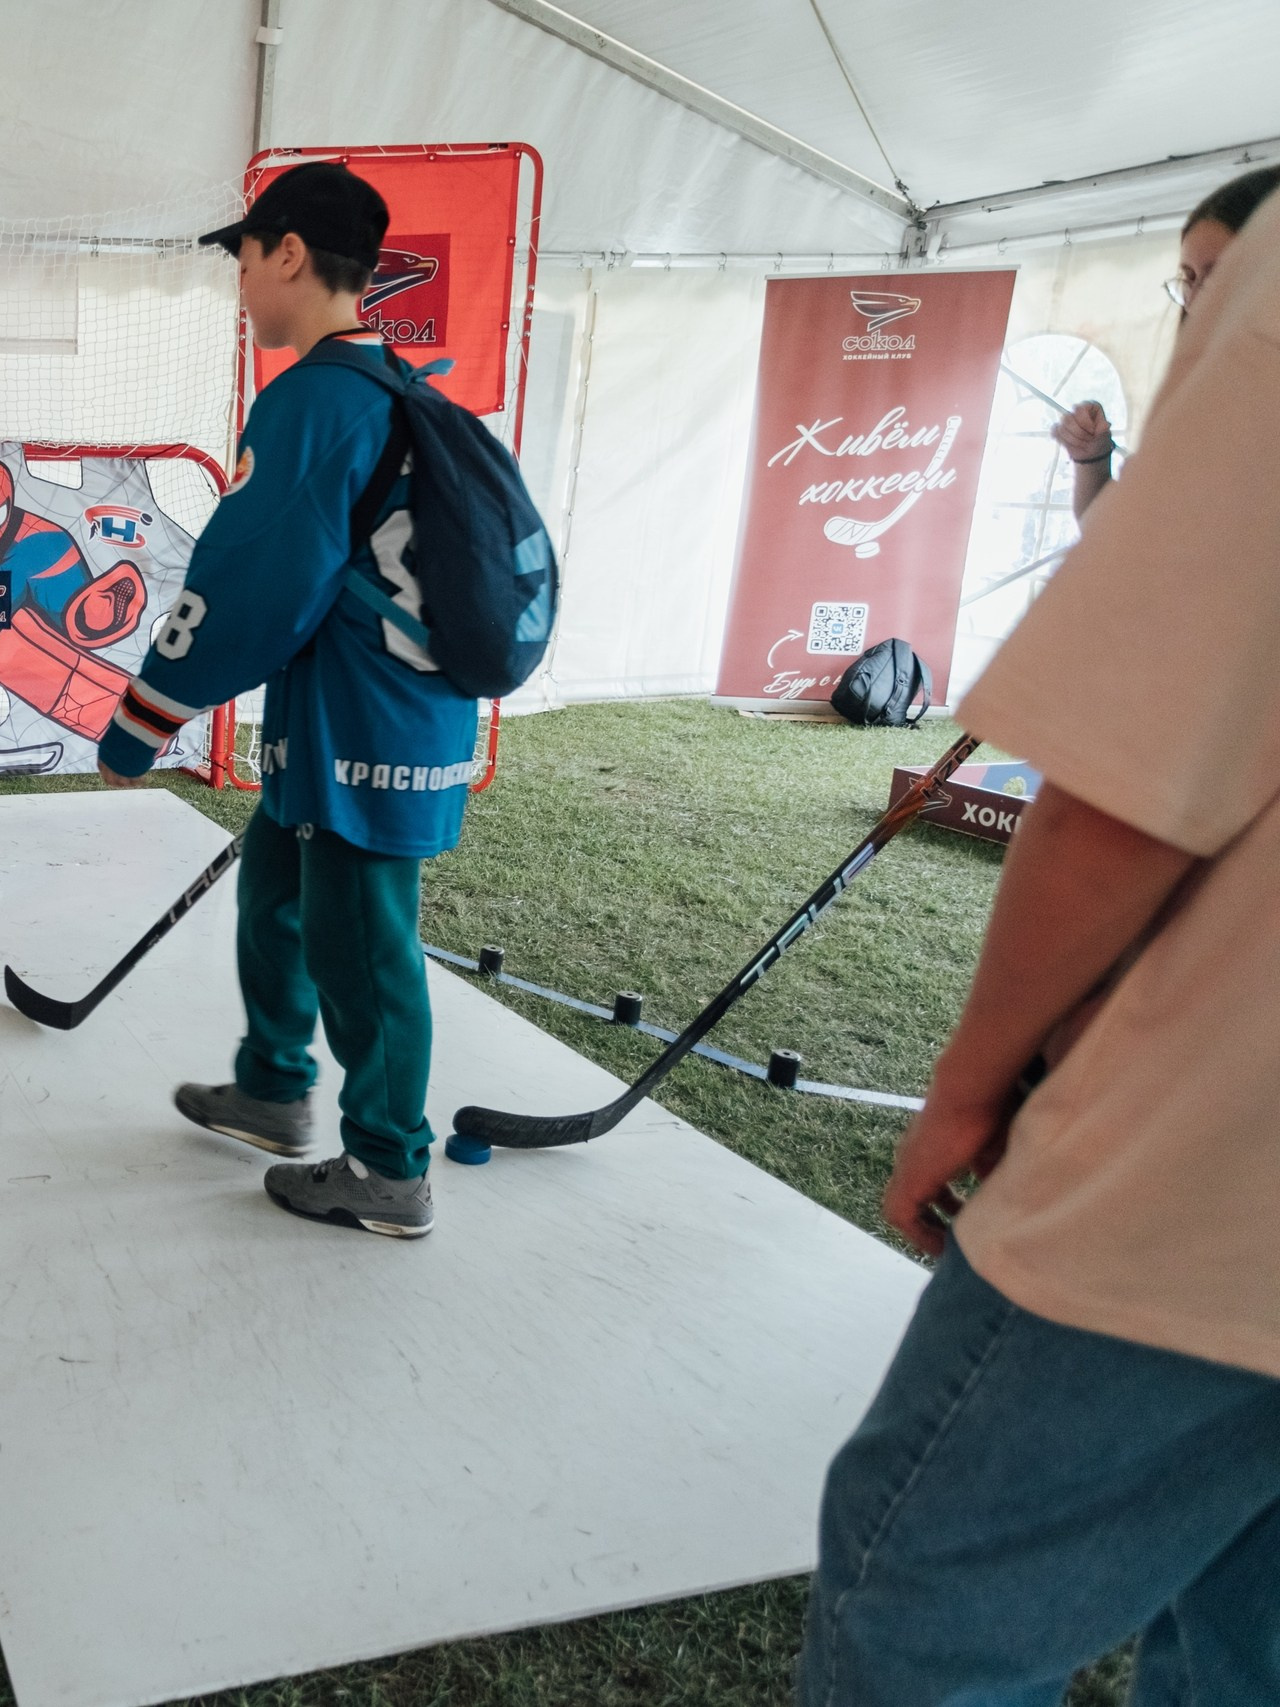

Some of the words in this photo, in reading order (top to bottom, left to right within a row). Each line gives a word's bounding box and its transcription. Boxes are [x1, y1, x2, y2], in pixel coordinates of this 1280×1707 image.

[767, 406, 941, 467] Живём
[798, 468, 957, 505] хоккеем
[156, 589, 208, 660] 8
[763, 671, 816, 699] Будь
[740, 842, 875, 985] TRUE
